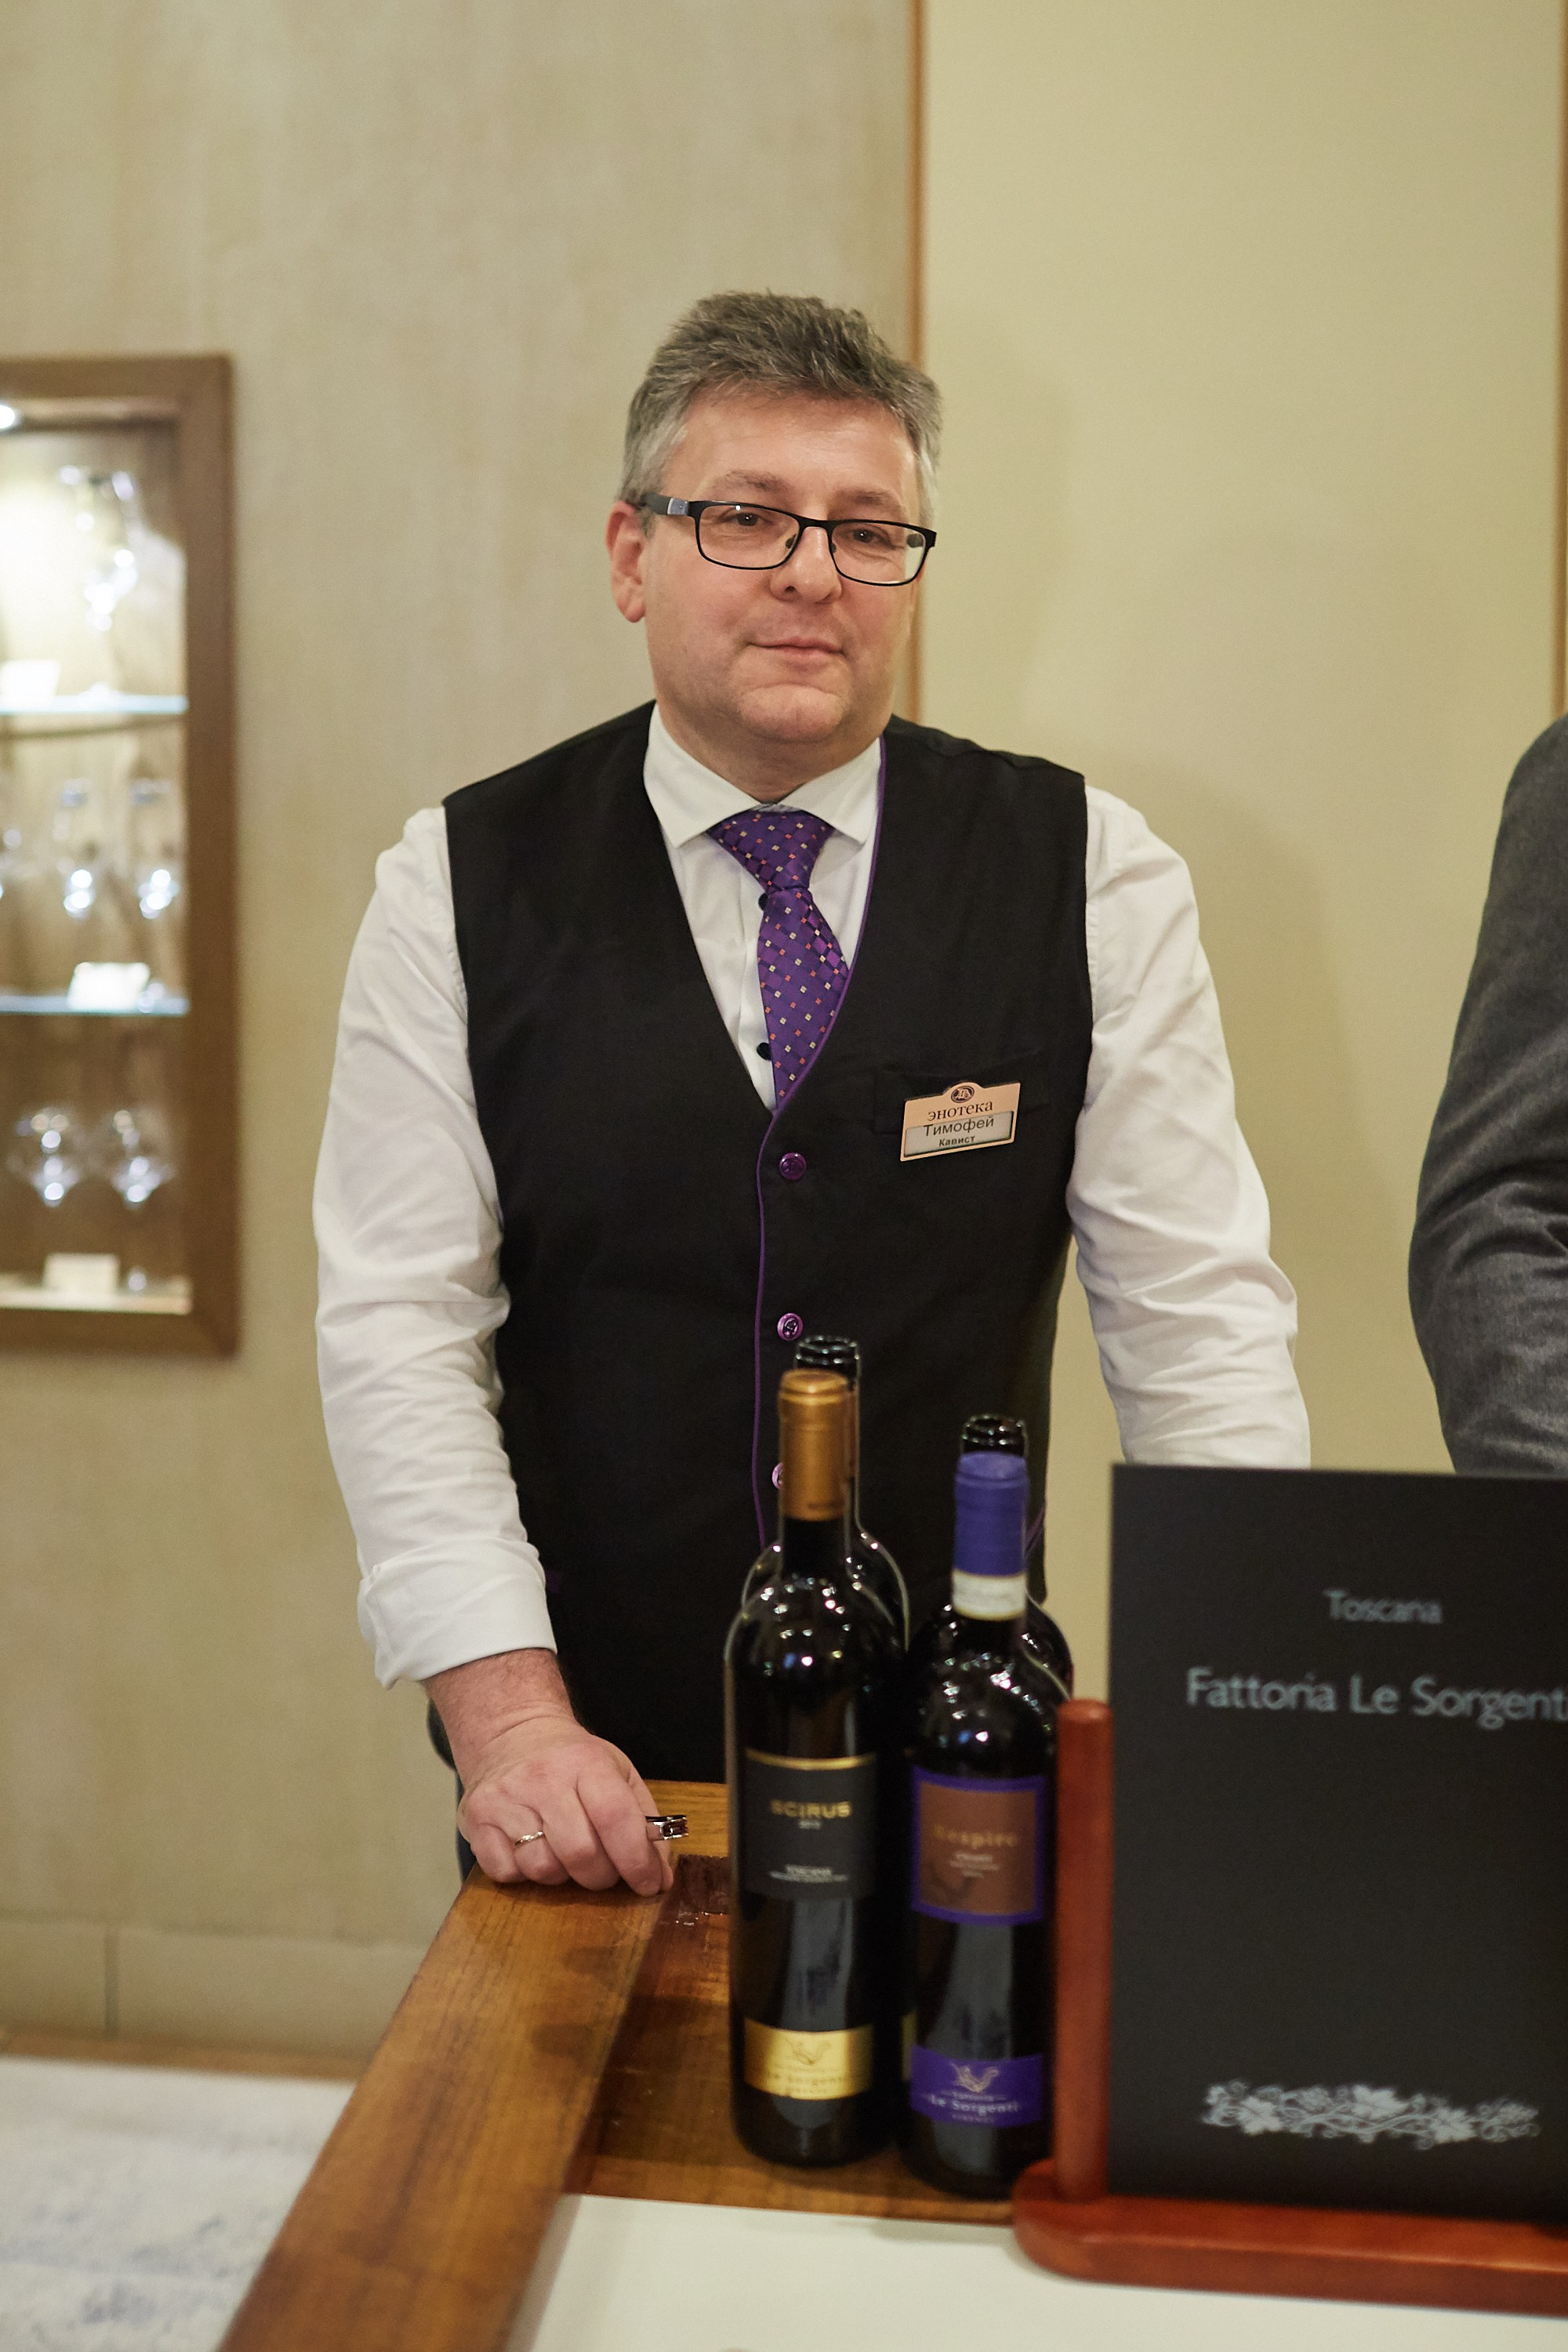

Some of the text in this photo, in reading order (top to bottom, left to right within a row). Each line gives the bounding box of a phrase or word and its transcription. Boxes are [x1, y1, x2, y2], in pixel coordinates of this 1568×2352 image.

[927, 1102, 993, 1122] энотека
[924, 1116, 994, 1137] Тимофей
[938, 1136, 975, 1147] Кавист
[1324, 1588, 1443, 1624] Toscana
[1186, 1666, 1338, 1712] Fattoria
[1350, 1672, 1399, 1715] Le
